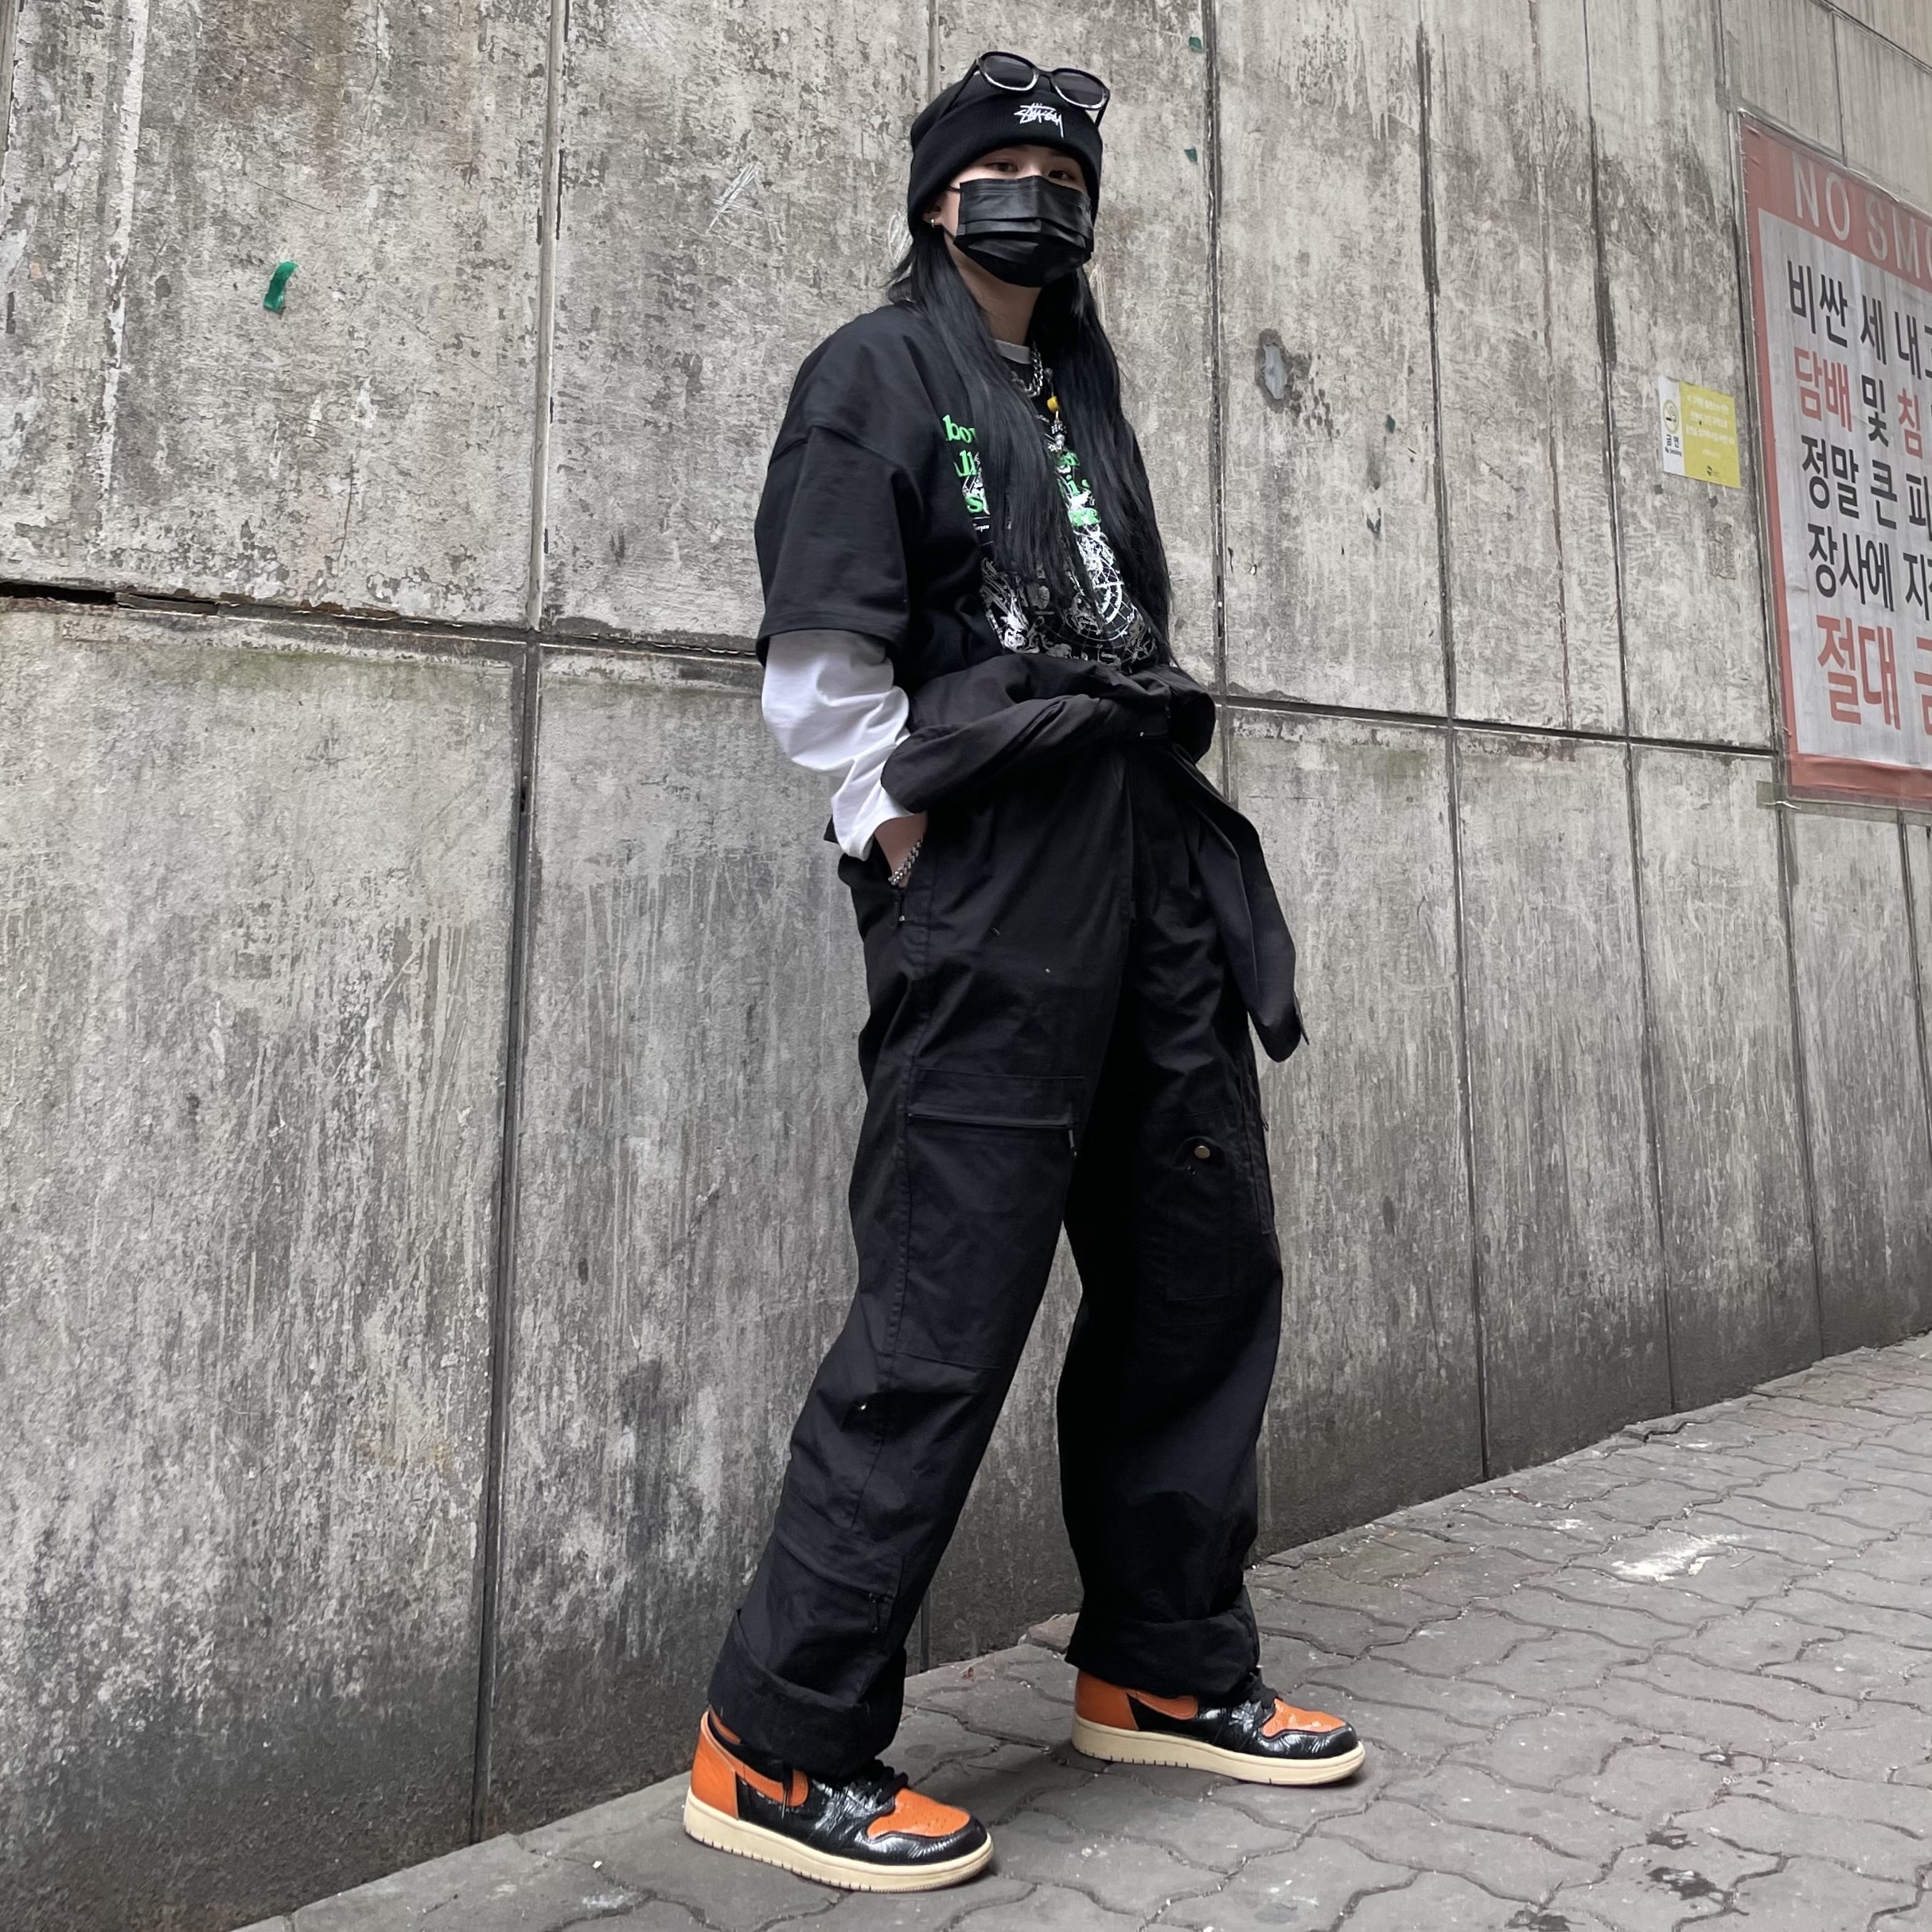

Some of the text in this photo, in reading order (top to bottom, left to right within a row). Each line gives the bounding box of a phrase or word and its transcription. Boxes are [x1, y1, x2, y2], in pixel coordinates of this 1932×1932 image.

[1792, 151, 1851, 241] NO
[1787, 259, 1848, 349] 비싼
[1860, 294, 1887, 365] 세
[1794, 346, 1923, 459] 담배 및 침
[1801, 434, 1860, 520] 정말
[1871, 459, 1898, 530] 큰
[1807, 523, 1932, 621] 장사에 지
[1817, 614, 1901, 730] 절대
